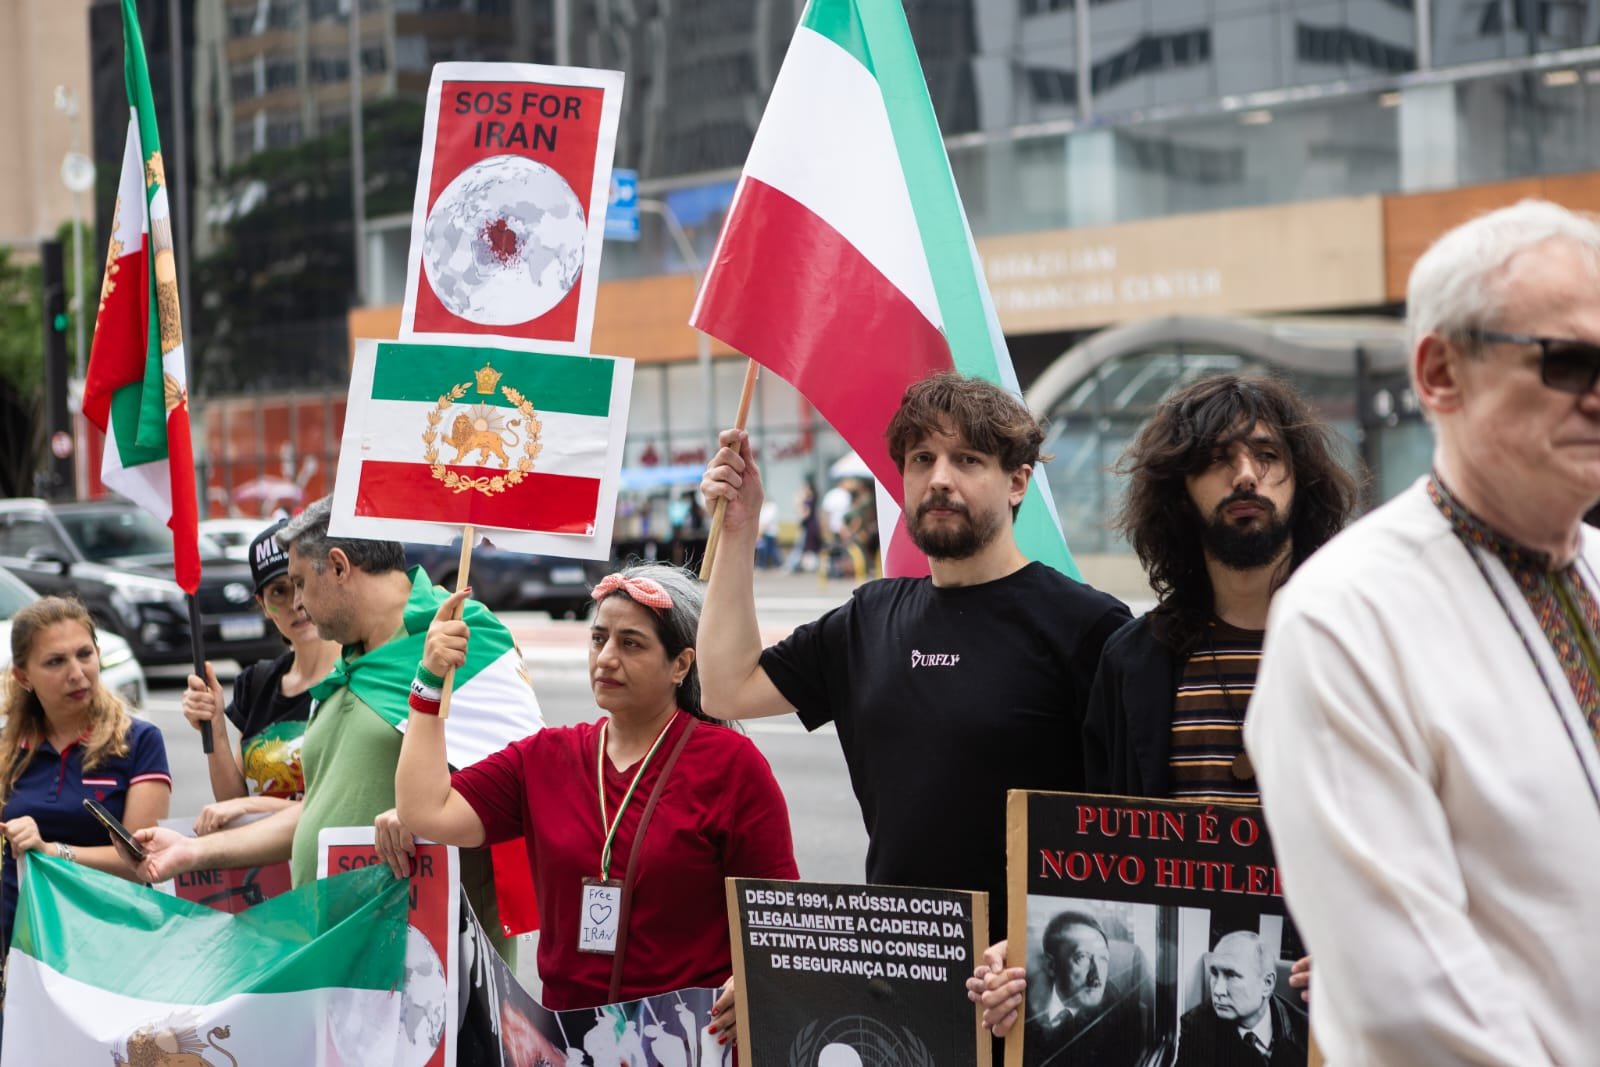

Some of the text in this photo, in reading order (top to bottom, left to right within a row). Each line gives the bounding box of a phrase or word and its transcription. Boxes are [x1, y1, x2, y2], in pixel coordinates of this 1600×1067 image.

[455, 92, 582, 120] SOS FOR
[473, 121, 558, 152] IRAN
[1120, 266, 1222, 303] CENTER
[1075, 804, 1260, 847] PUTIN É O
[178, 868, 224, 887] LINE
[1039, 849, 1146, 885] NOVO
[589, 888, 613, 901] Free
[745, 889, 964, 917] DESDE 1991, A RÚSSIA OCUPA
[583, 926, 615, 942] IRAN
[747, 910, 965, 939] ILEGALMENTE A CADEIRA DA
[749, 931, 966, 961] EXTINTA URSS NO CONSELHO
[771, 954, 947, 982] DE SEGURANÇA DA ONU!
